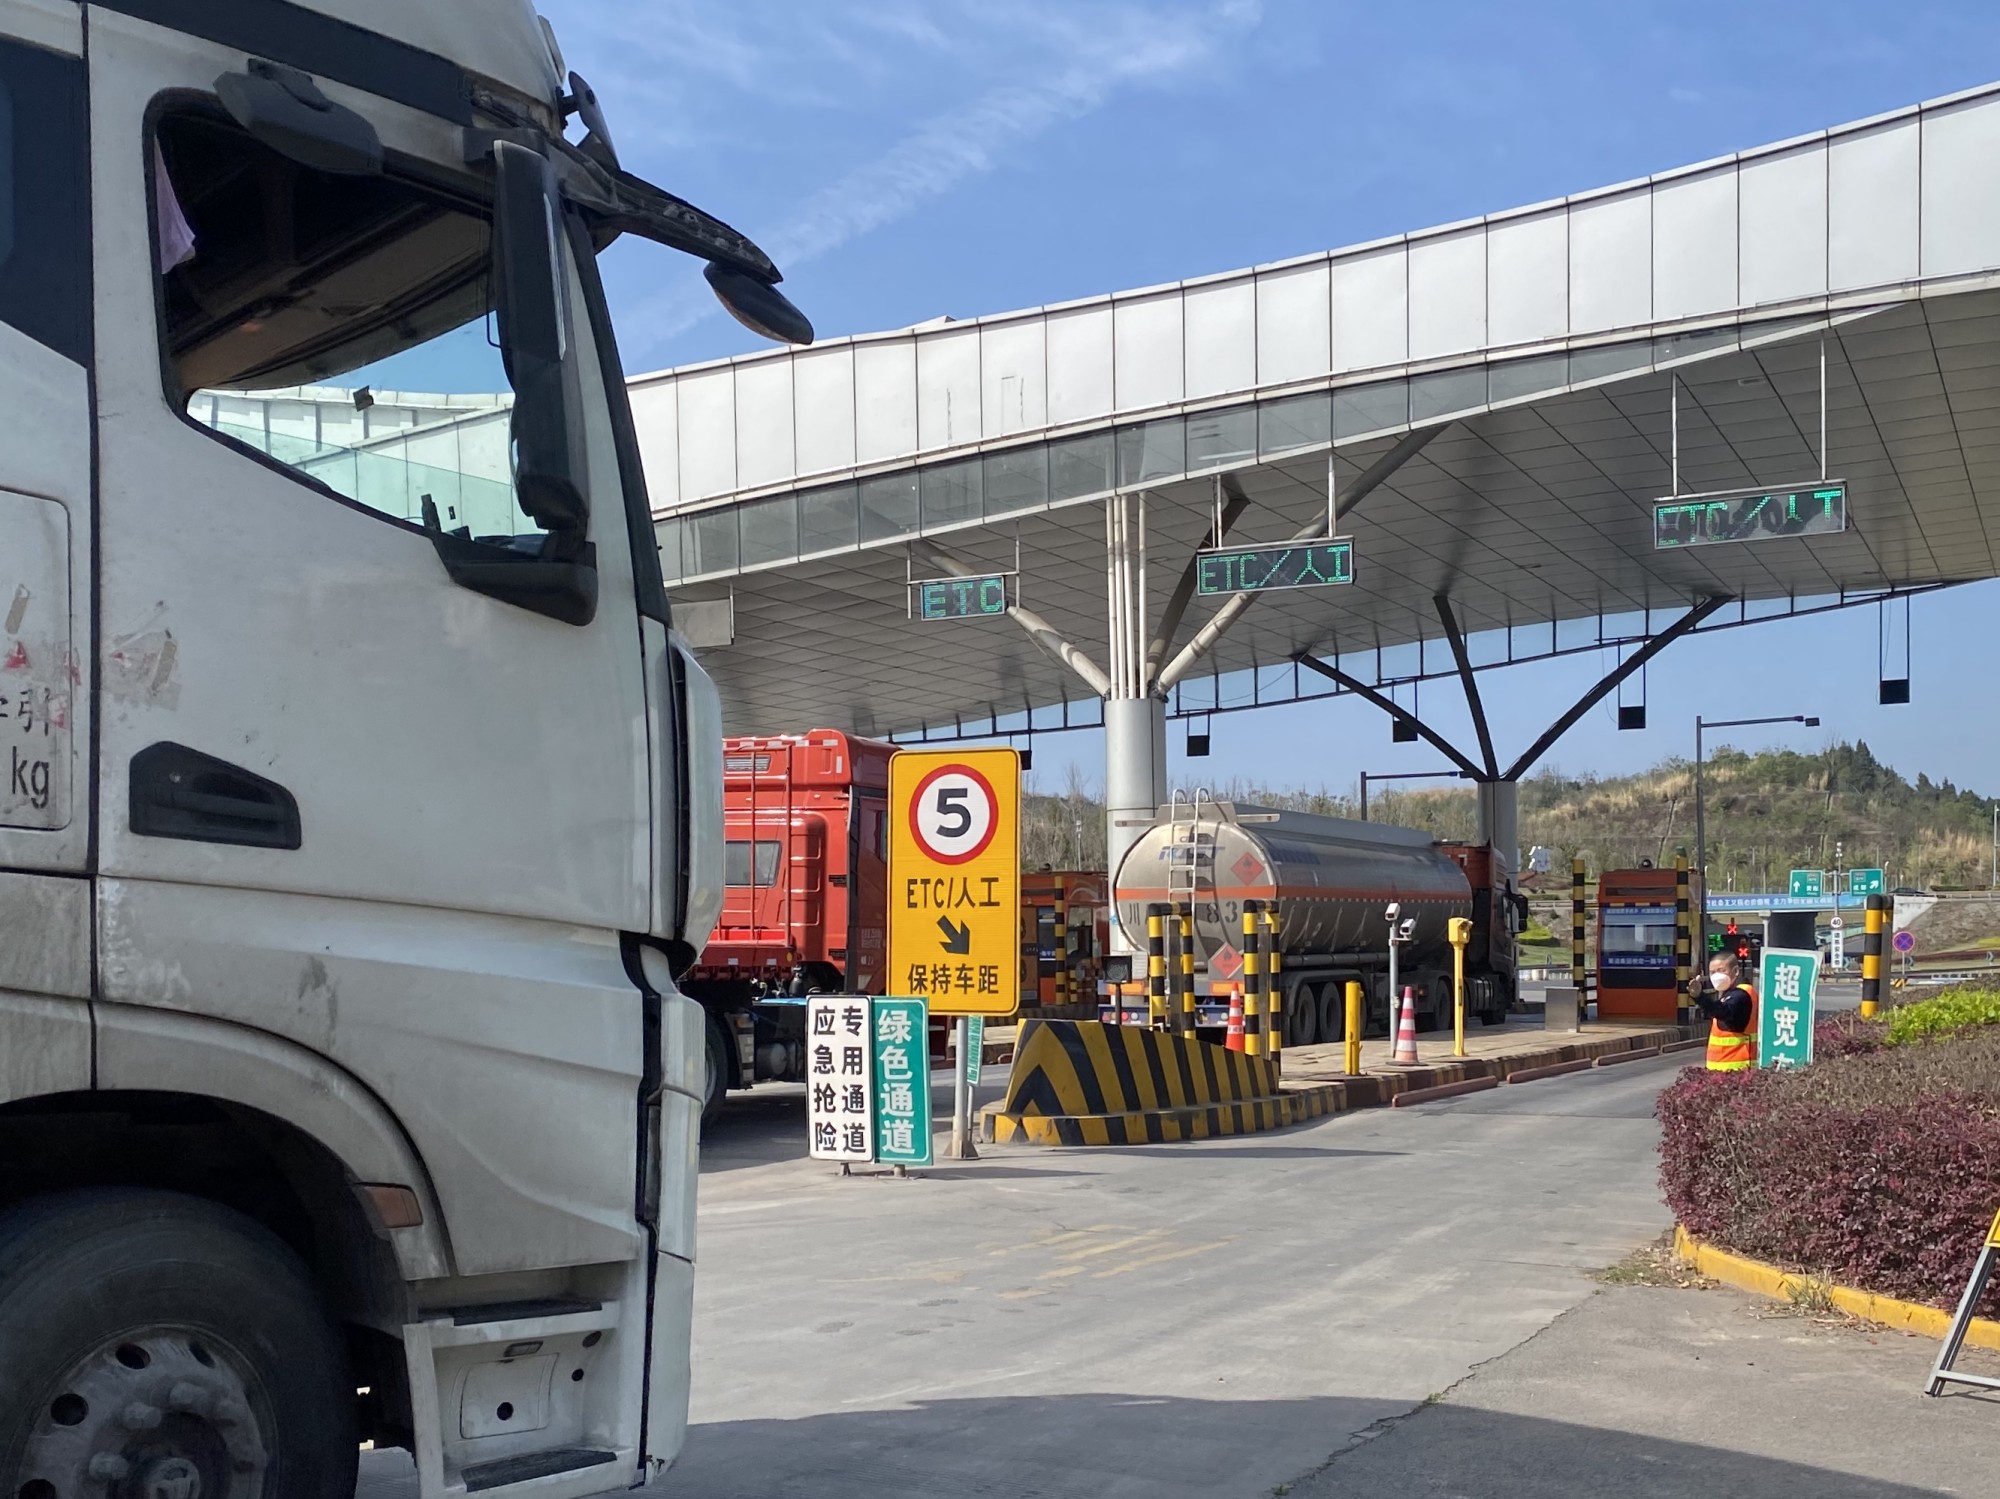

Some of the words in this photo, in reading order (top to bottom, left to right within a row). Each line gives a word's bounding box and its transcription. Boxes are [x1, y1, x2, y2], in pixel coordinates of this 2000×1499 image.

[1199, 545, 1351, 592] ETC/人工
[923, 584, 1002, 618] ETC
[0, 688, 49, 736] 引
[12, 746, 49, 809] kg
[936, 787, 972, 838] 5
[907, 877, 1000, 908] ETC/人工
[907, 963, 999, 995] 保持车距
[813, 1005, 837, 1154] 应急抢险
[840, 1004, 867, 1154] 专用通道
[877, 1008, 916, 1155] 绿色通道
